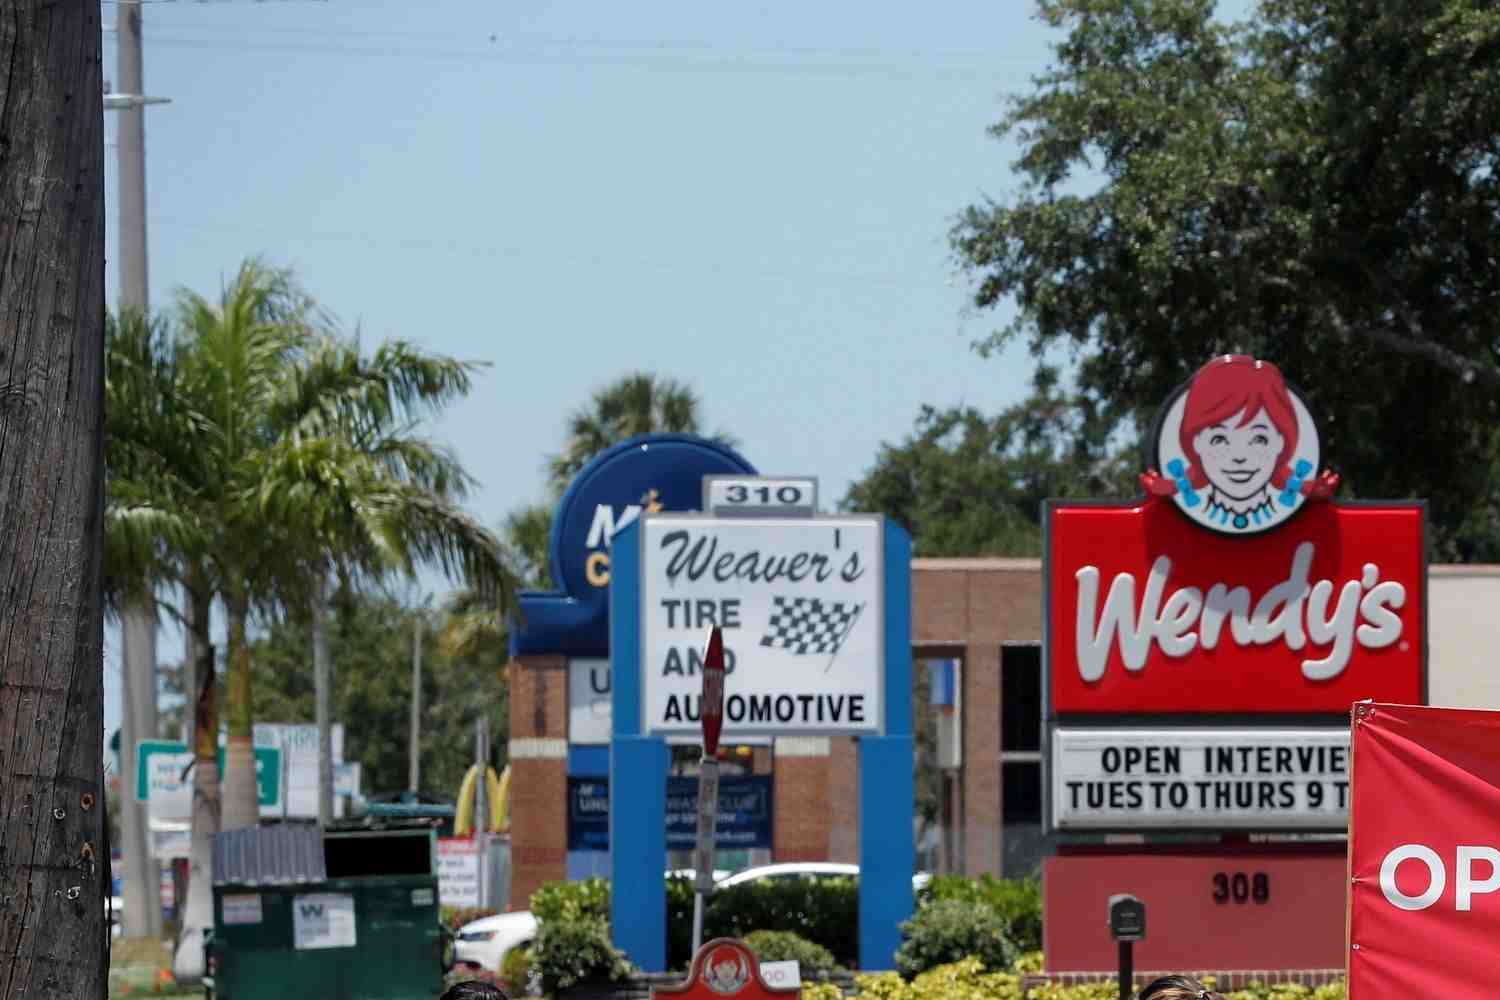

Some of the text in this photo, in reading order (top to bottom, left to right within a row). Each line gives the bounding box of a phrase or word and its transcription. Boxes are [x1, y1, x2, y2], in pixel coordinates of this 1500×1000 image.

[725, 486, 802, 504] 310
[660, 528, 865, 584] Weaver's
[661, 599, 742, 629] TIRE
[1075, 541, 1406, 682] Wendy's
[663, 694, 865, 722] AUOMOTIVE
[1101, 746, 1350, 773] OPEN INTERVIE
[1066, 781, 1349, 809] TUES TO THURS 9 T
[1212, 872, 1270, 902] 308
